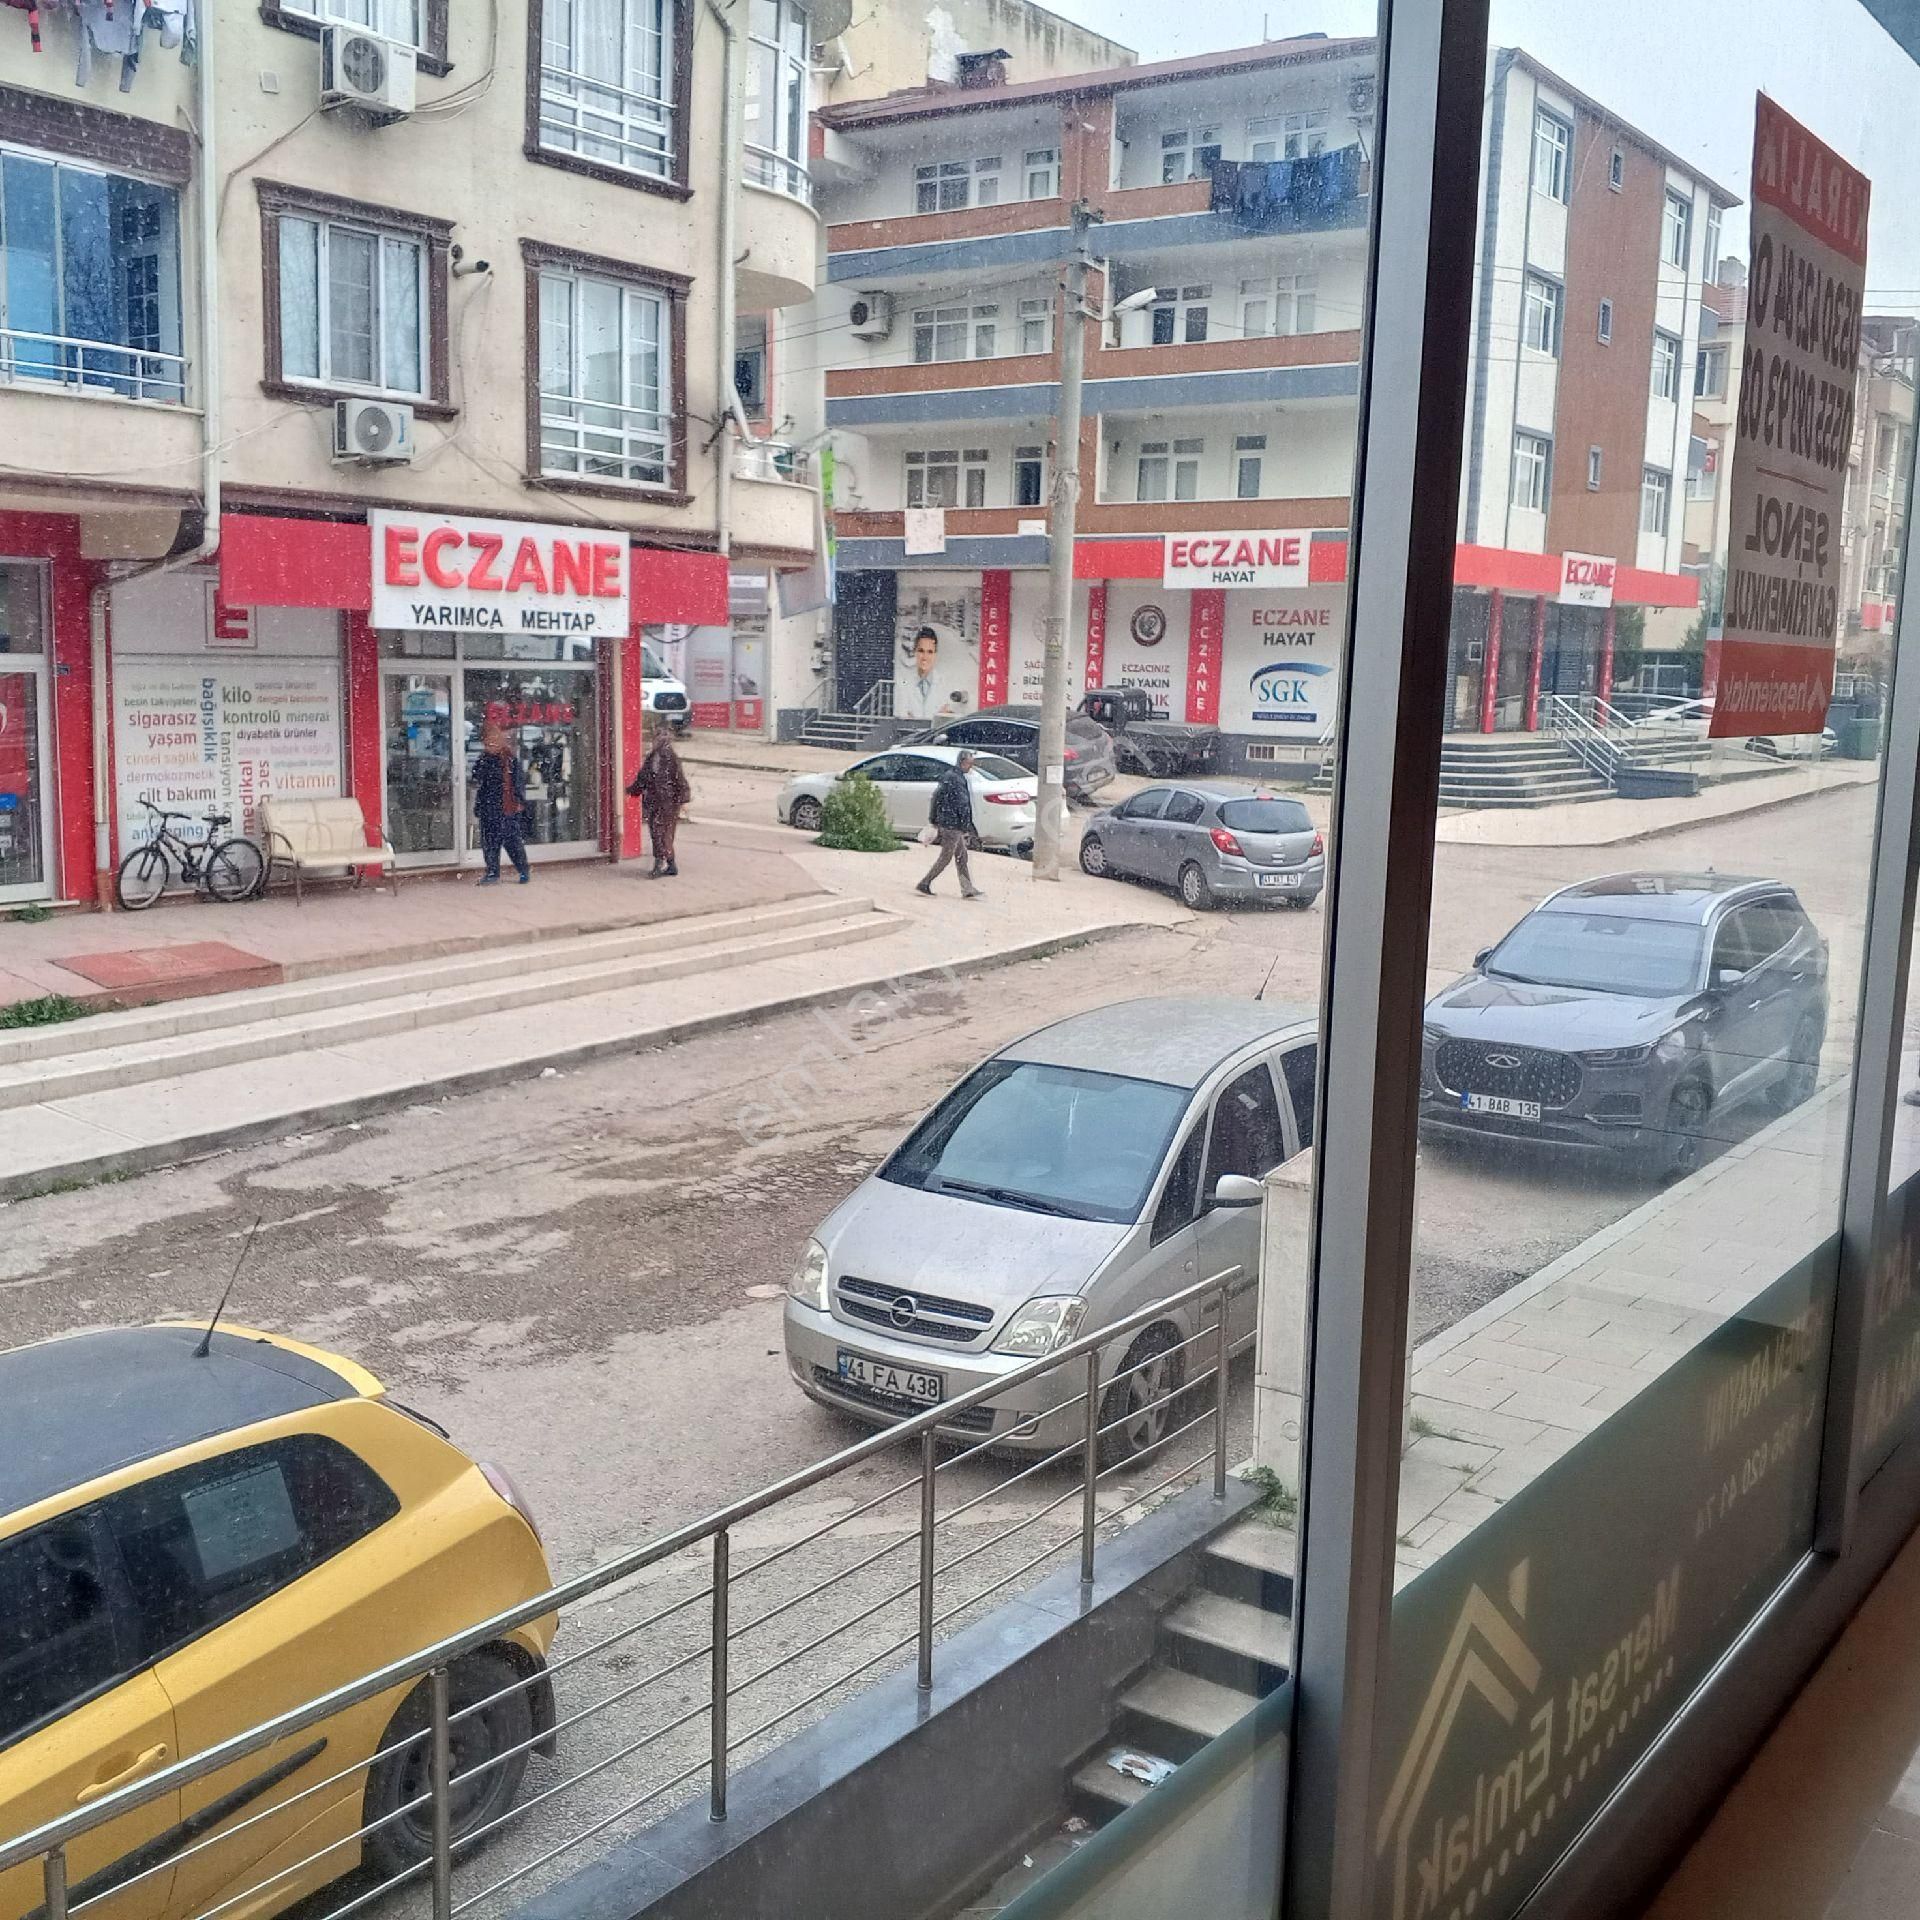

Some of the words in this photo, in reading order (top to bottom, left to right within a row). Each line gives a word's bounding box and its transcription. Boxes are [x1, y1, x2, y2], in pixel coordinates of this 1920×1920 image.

[384, 525, 621, 597] ECZANE
[1170, 538, 1301, 567] ECZANE
[1212, 570, 1256, 583] HAYAT
[411, 604, 503, 628] YARIMCA
[521, 609, 596, 632] MEHTAP
[1251, 609, 1330, 626] ECZANE
[1086, 607, 1101, 689] ECZAN
[1263, 632, 1316, 646] HAYAT
[986, 607, 1000, 702] ECZANE
[1195, 607, 1209, 711] ECZANE
[1121, 663, 1171, 673] ECZACINIZ
[1136, 677, 1171, 688] YAKIN
[1258, 679, 1309, 703] SGK
[222, 686, 252, 703] kilo
[128, 710, 197, 729] sigarasız
[148, 732, 197, 748] yaşam
[283, 728, 317, 739] ürünler
[274, 772, 336, 790] vitamin
[166, 785, 217, 801] bakımı
[238, 760, 255, 837] medikal
[1519, 1102, 1539, 1117] 135
[848, 1358, 866, 1380] 41
[872, 1365, 900, 1391] FA
[906, 1373, 938, 1398] 438
